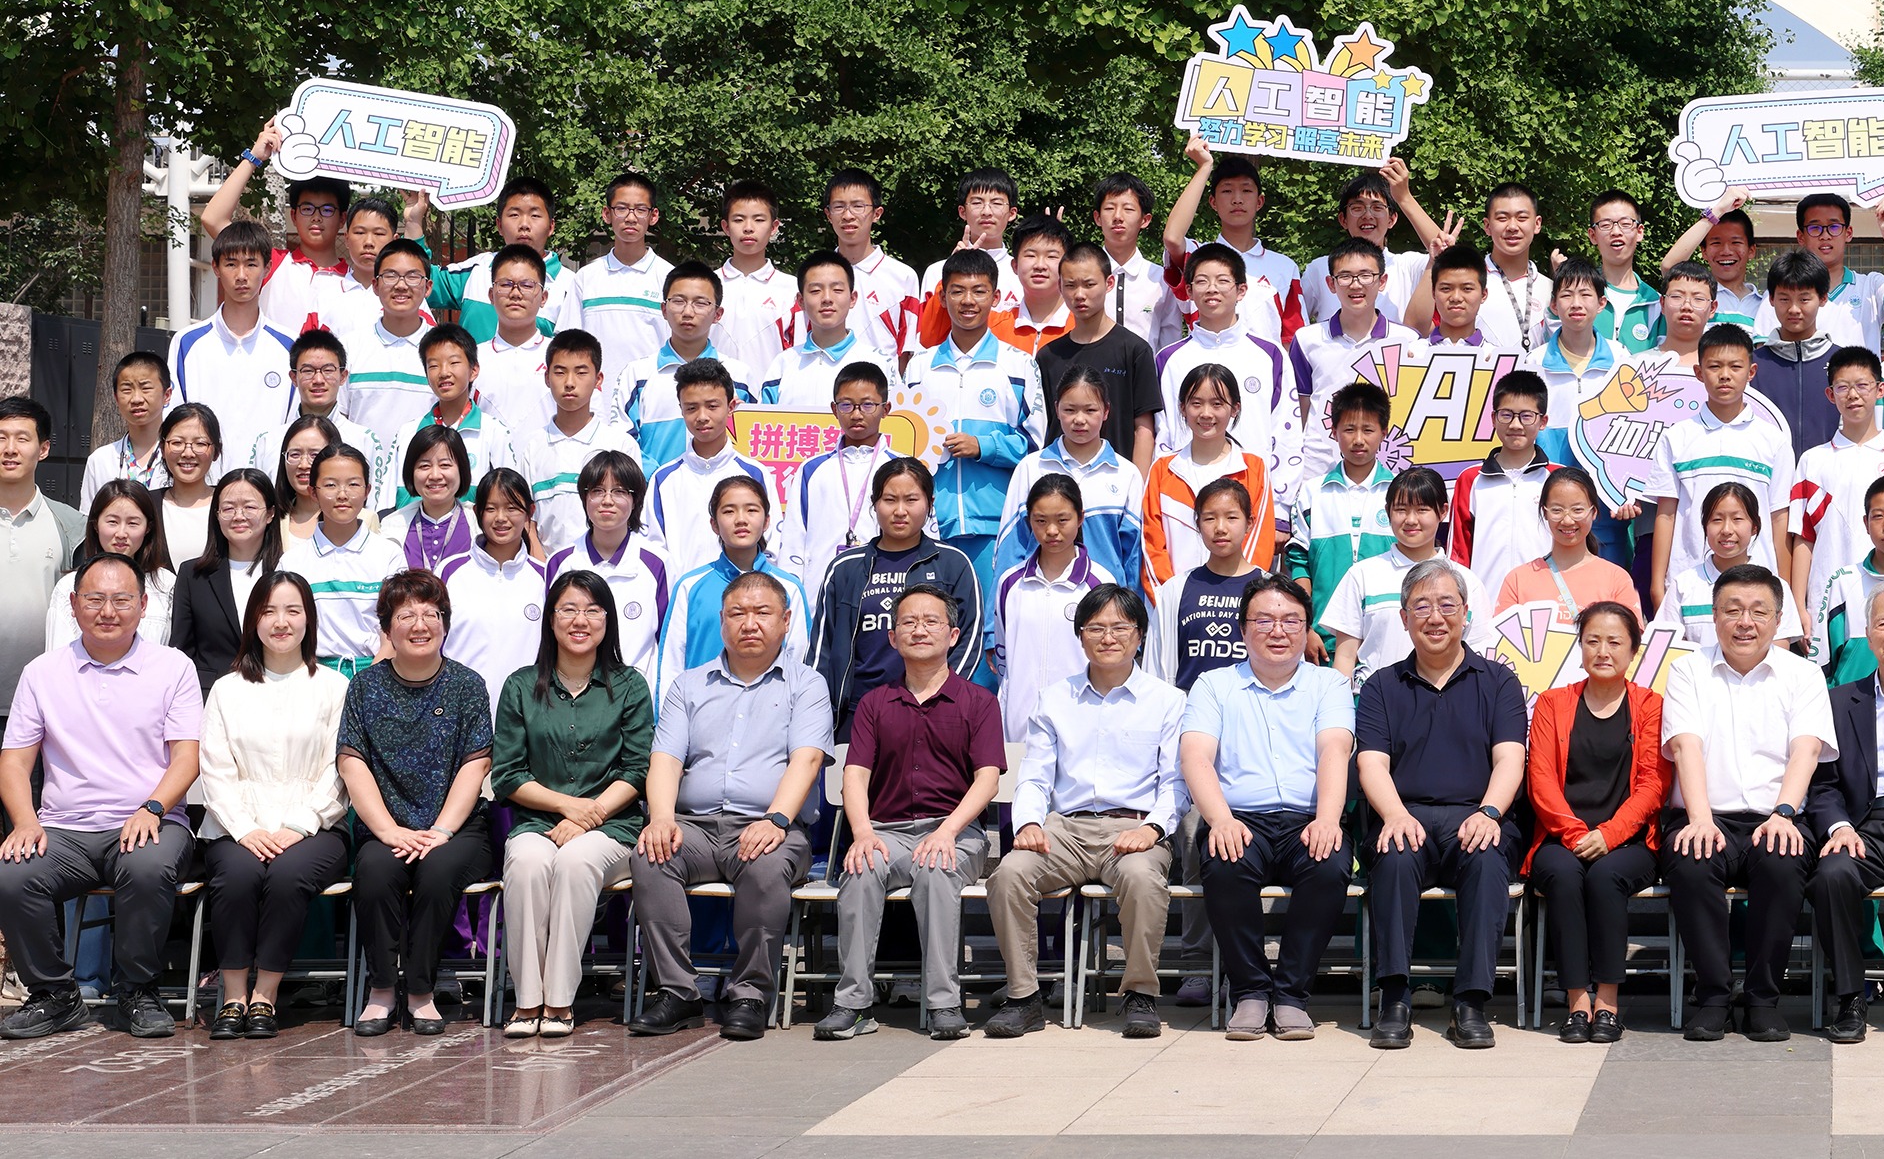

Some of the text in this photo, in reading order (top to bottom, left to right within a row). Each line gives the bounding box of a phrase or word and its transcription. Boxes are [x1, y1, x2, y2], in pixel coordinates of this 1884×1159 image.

[1203, 76, 1395, 127] 人工智能
[318, 109, 487, 168] 人工智能
[1199, 116, 1385, 160] 努力学习 照亮未来
[1181, 610, 1217, 627] NATIONAL
[1218, 611, 1234, 619] DAY
[1188, 639, 1249, 660] BNDS
